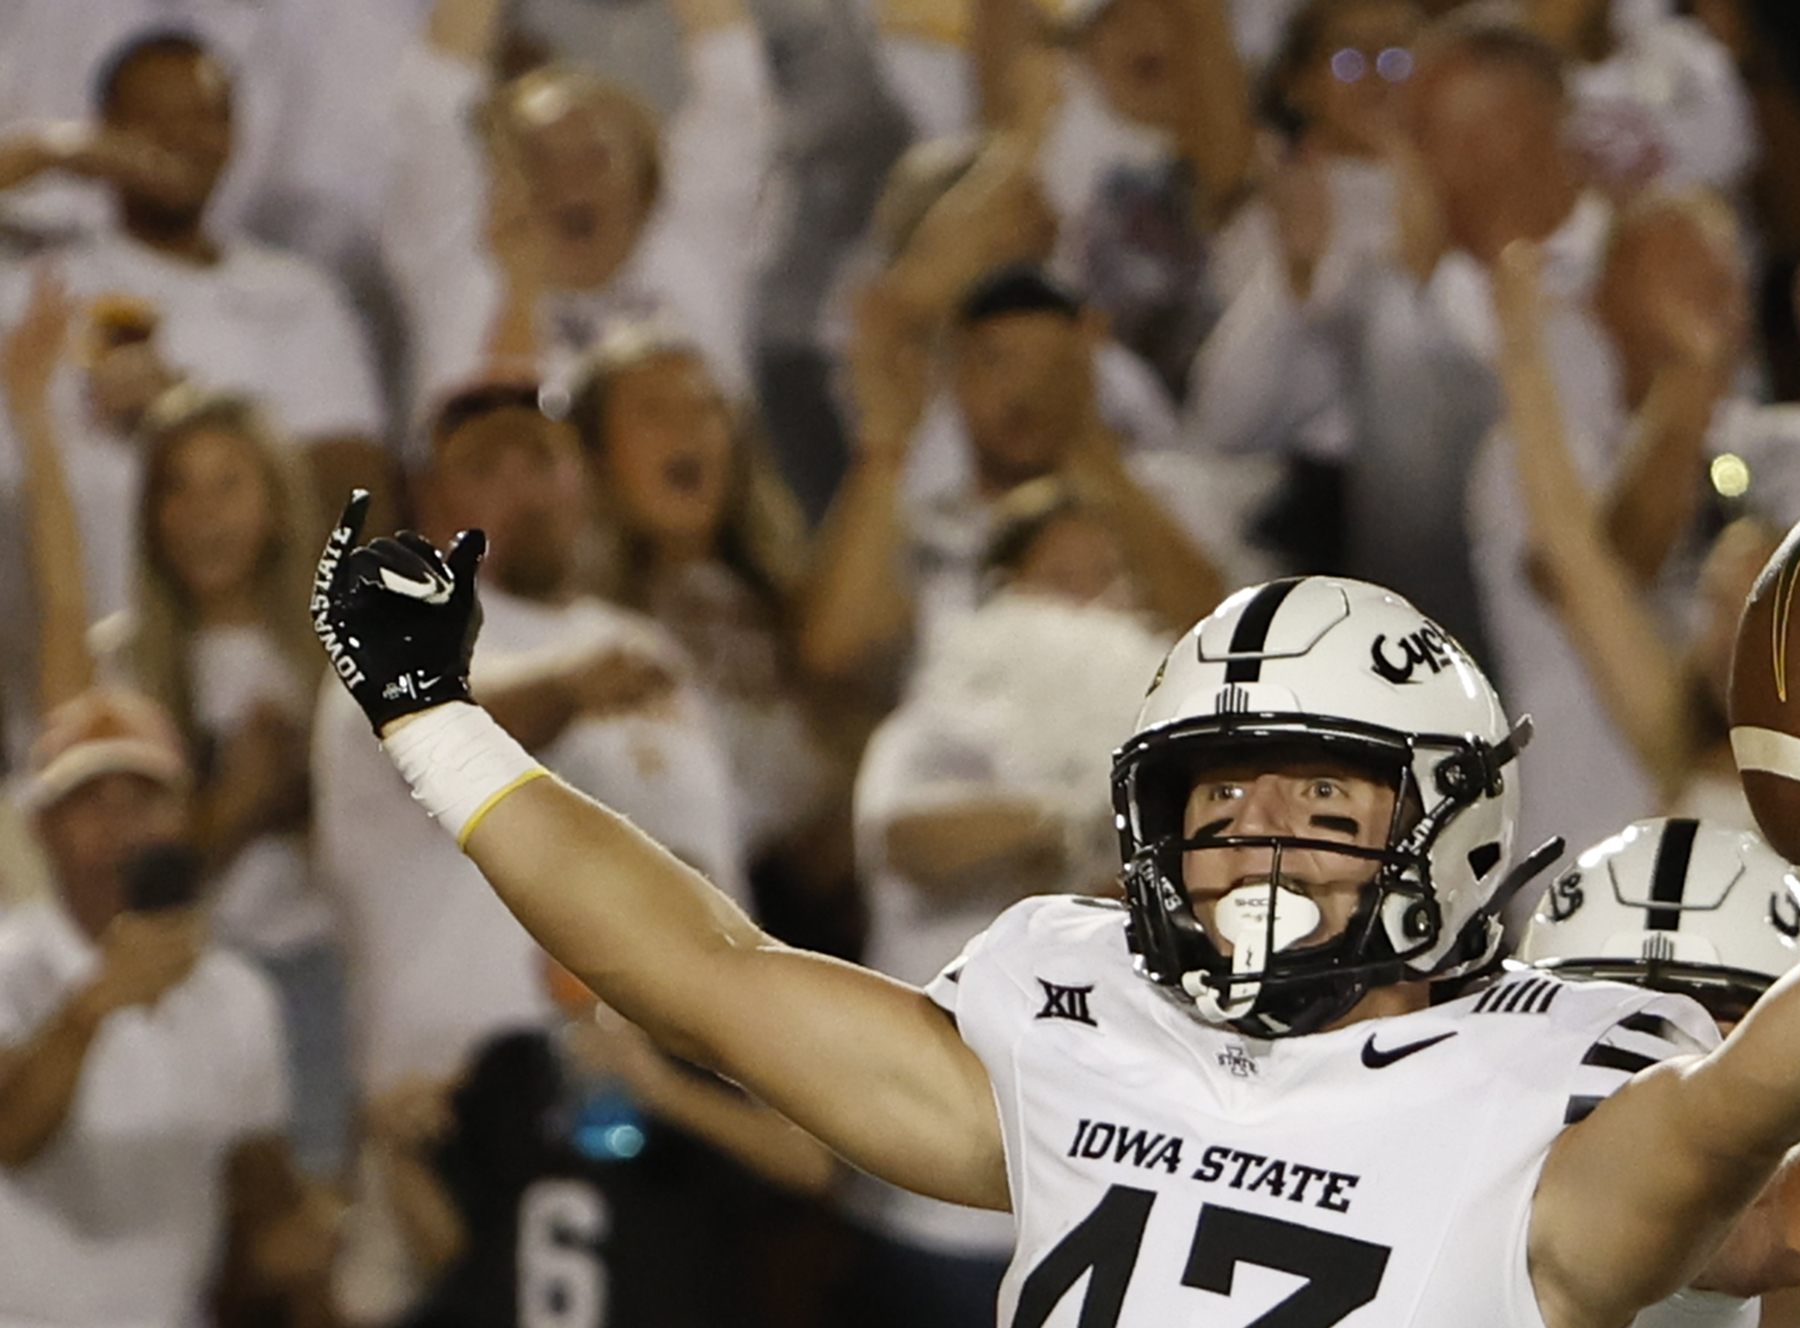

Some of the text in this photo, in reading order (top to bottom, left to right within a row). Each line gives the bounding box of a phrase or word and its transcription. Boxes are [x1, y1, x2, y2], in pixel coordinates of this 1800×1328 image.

[1034, 977, 1099, 1028] XII
[1067, 1119, 1359, 1214] IOWA STATE
